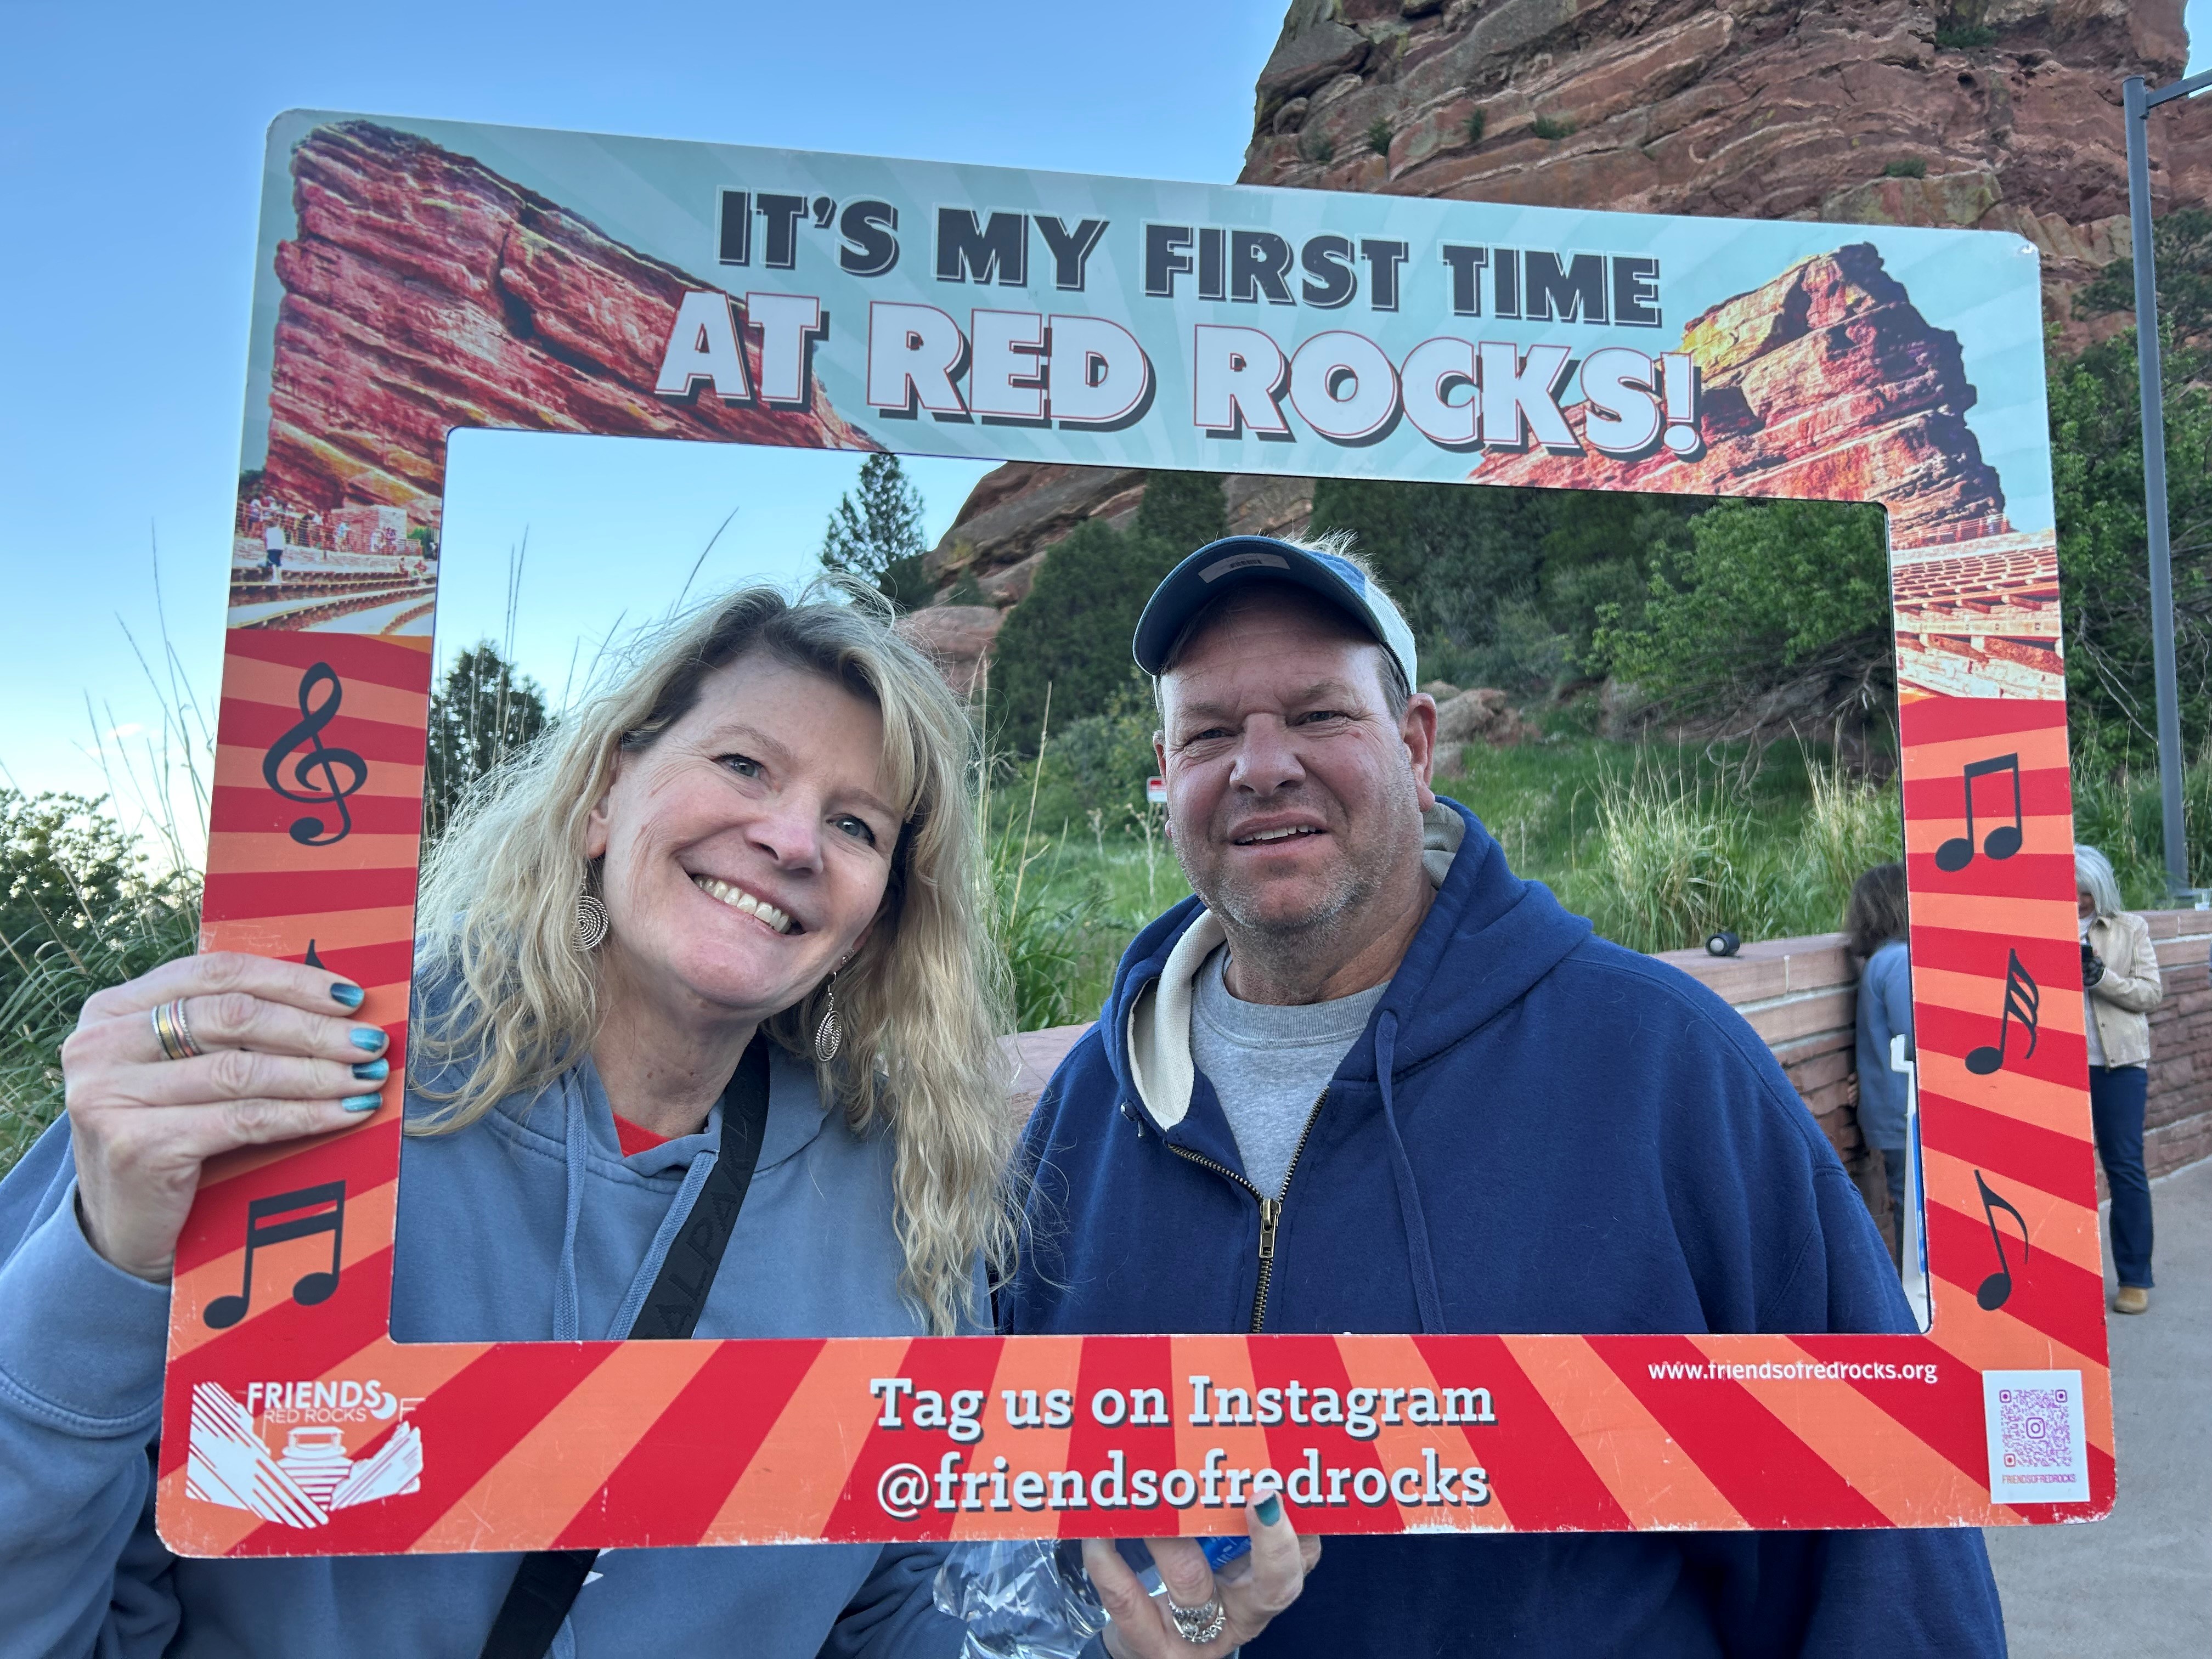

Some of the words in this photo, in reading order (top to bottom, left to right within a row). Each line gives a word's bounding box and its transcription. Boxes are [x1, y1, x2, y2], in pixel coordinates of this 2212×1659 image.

[716, 185, 900, 277] IT'S
[932, 202, 1110, 292] MY
[1140, 220, 1409, 313] FIRST
[1437, 240, 1662, 328] TIME
[653, 289, 830, 413] AT
[867, 300, 1156, 432] RED
[1194, 324, 1708, 465] ROCKS!
[247, 1379, 382, 1413] FRIENDS
[1647, 1359, 1938, 1384] www.friendsofredrocks.org
[264, 1408, 300, 1425] RED
[309, 1407, 367, 1423] ROCKS
[870, 1377, 984, 1443] Tag
[1001, 1386, 1073, 1429] us
[1091, 1385, 1171, 1427] on
[1187, 1374, 1499, 1441] Instagram
[877, 1447, 1491, 1520] @friendsofredrocks
